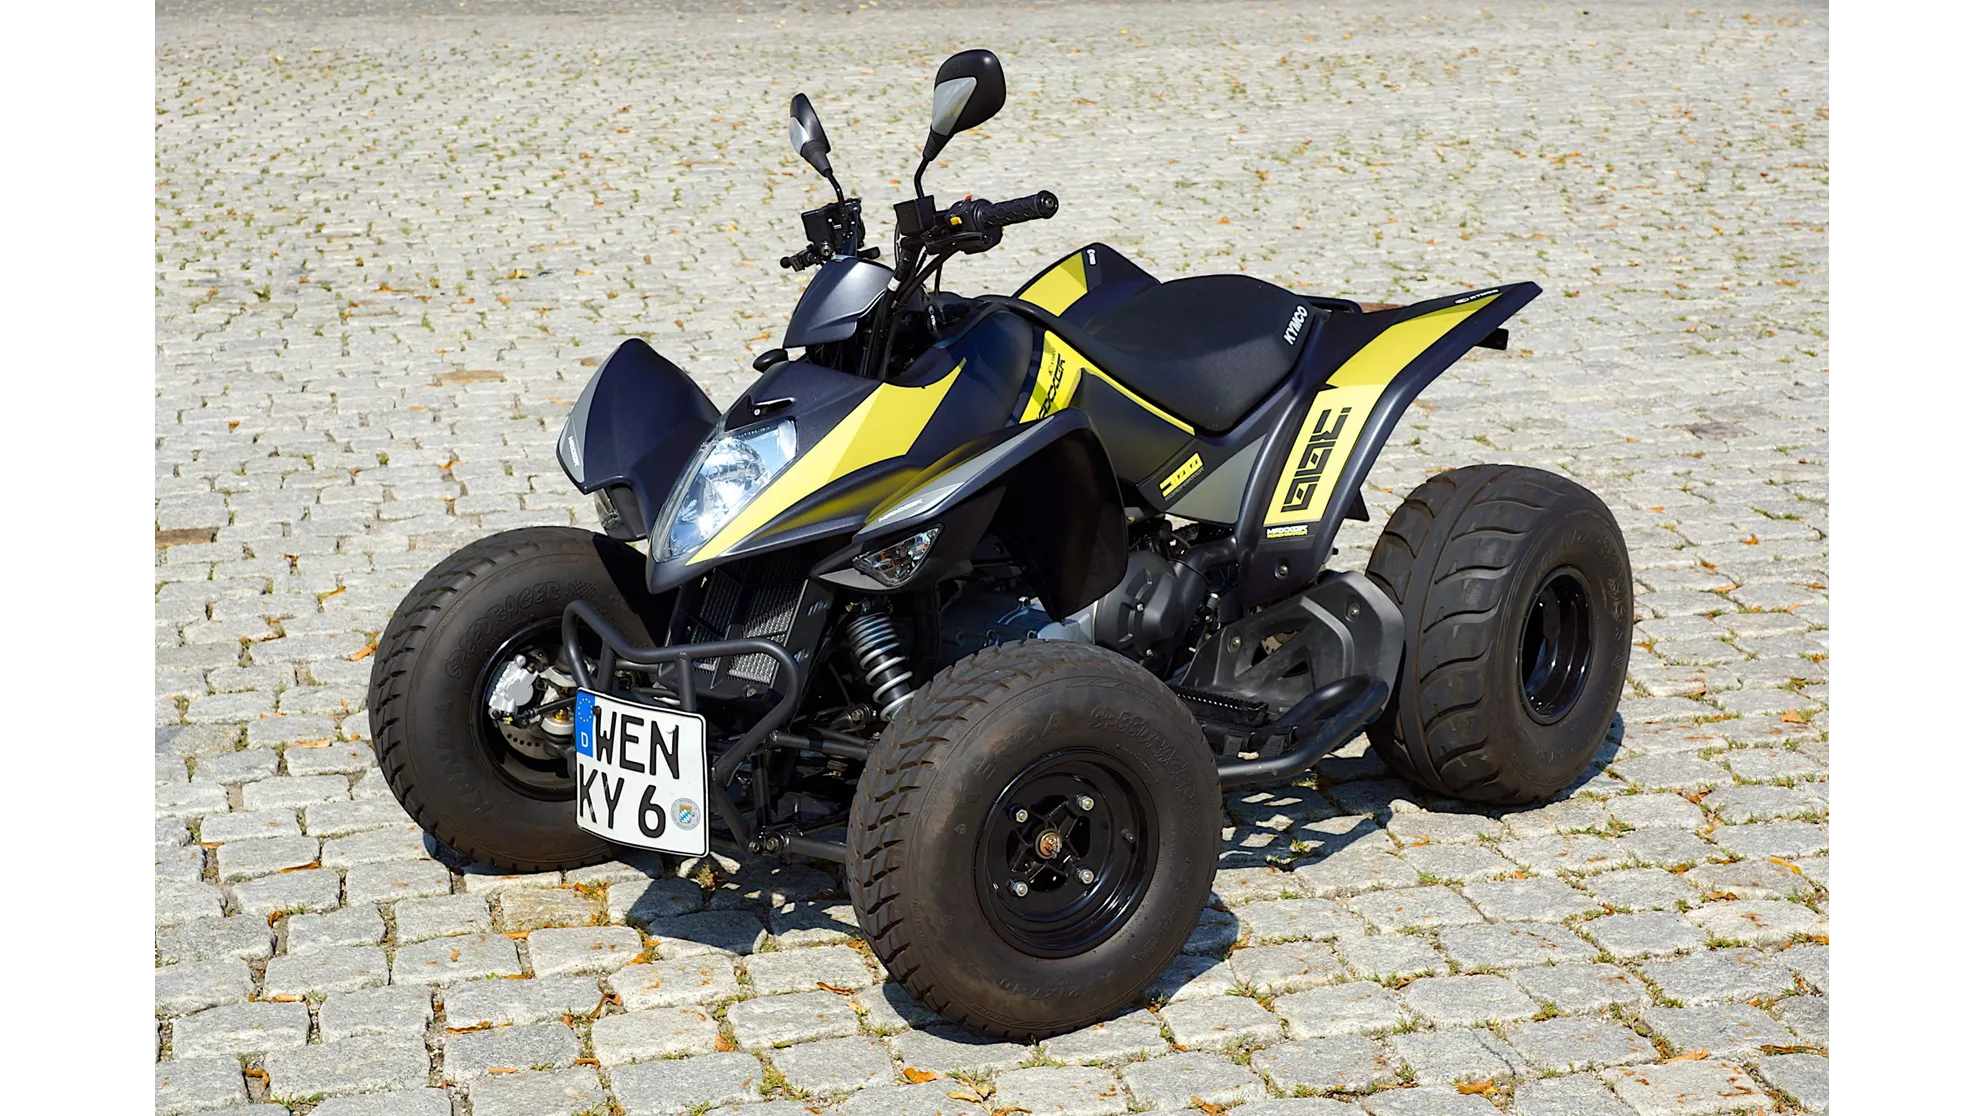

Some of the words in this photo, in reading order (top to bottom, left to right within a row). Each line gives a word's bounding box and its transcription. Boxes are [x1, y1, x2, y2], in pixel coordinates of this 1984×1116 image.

[1284, 305, 1308, 346] KYMCO
[1159, 452, 1204, 497] 300
[581, 731, 589, 748] D
[595, 706, 680, 780] WEN
[579, 763, 625, 829] KY
[638, 784, 666, 839] 6
